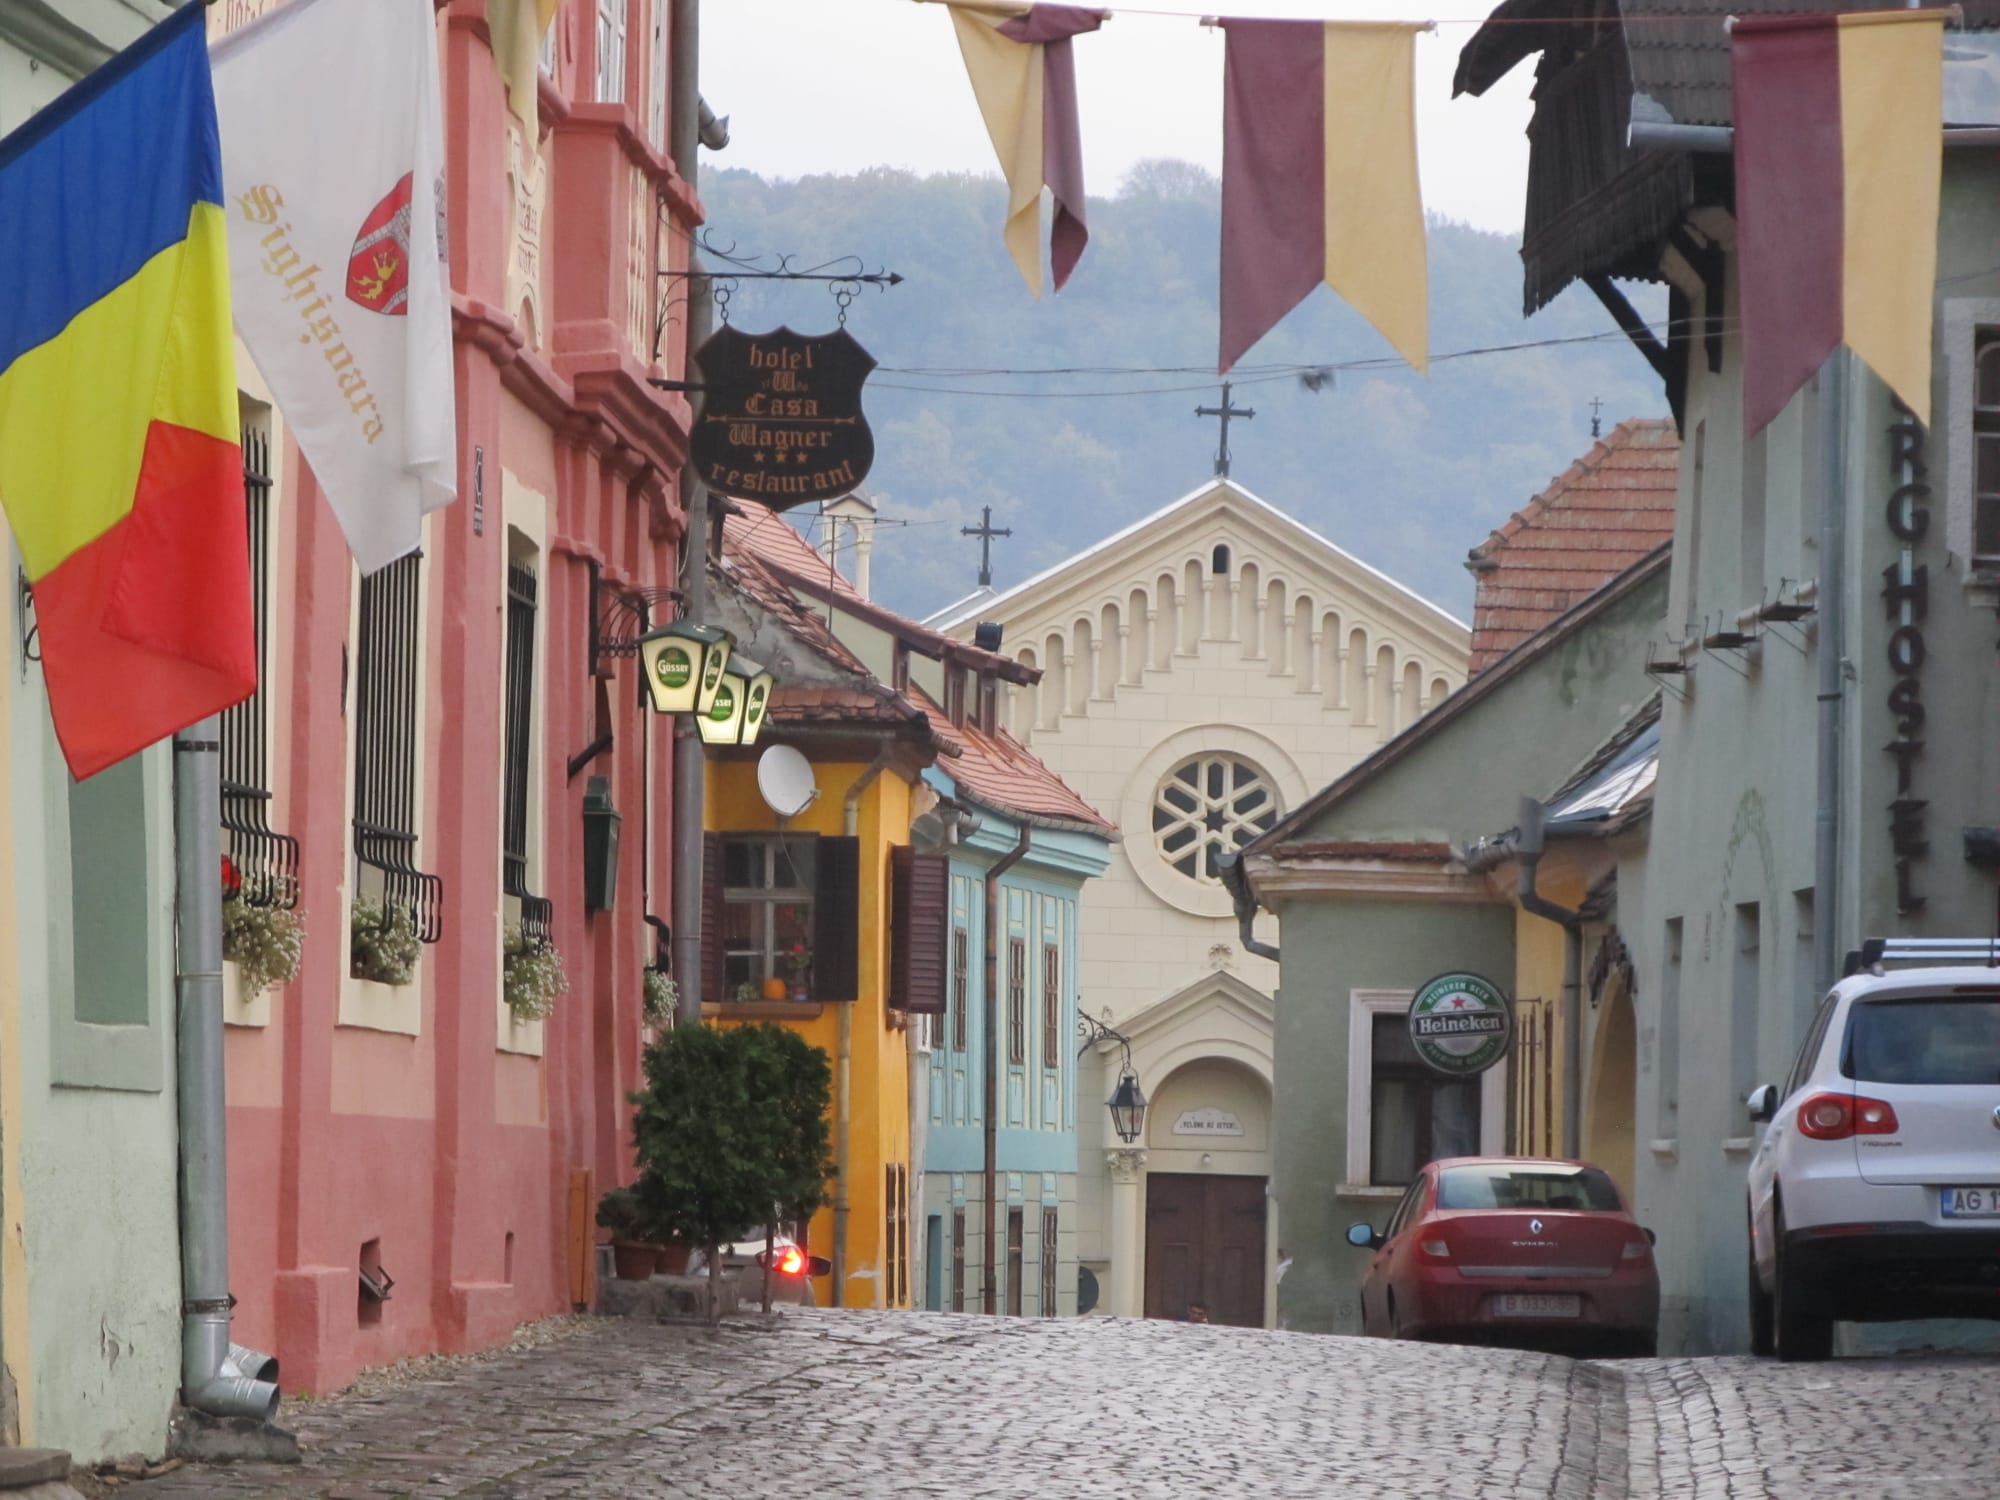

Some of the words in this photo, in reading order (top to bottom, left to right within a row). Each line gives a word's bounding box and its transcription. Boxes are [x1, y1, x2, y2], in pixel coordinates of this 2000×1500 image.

[749, 343, 813, 369] hotel
[744, 393, 818, 417] Casa
[729, 423, 832, 450] Wagner
[711, 459, 854, 493] restaurant
[714, 699, 732, 708] sser
[1420, 1015, 1500, 1034] Heineken
[1954, 1190, 1982, 1211] AG
